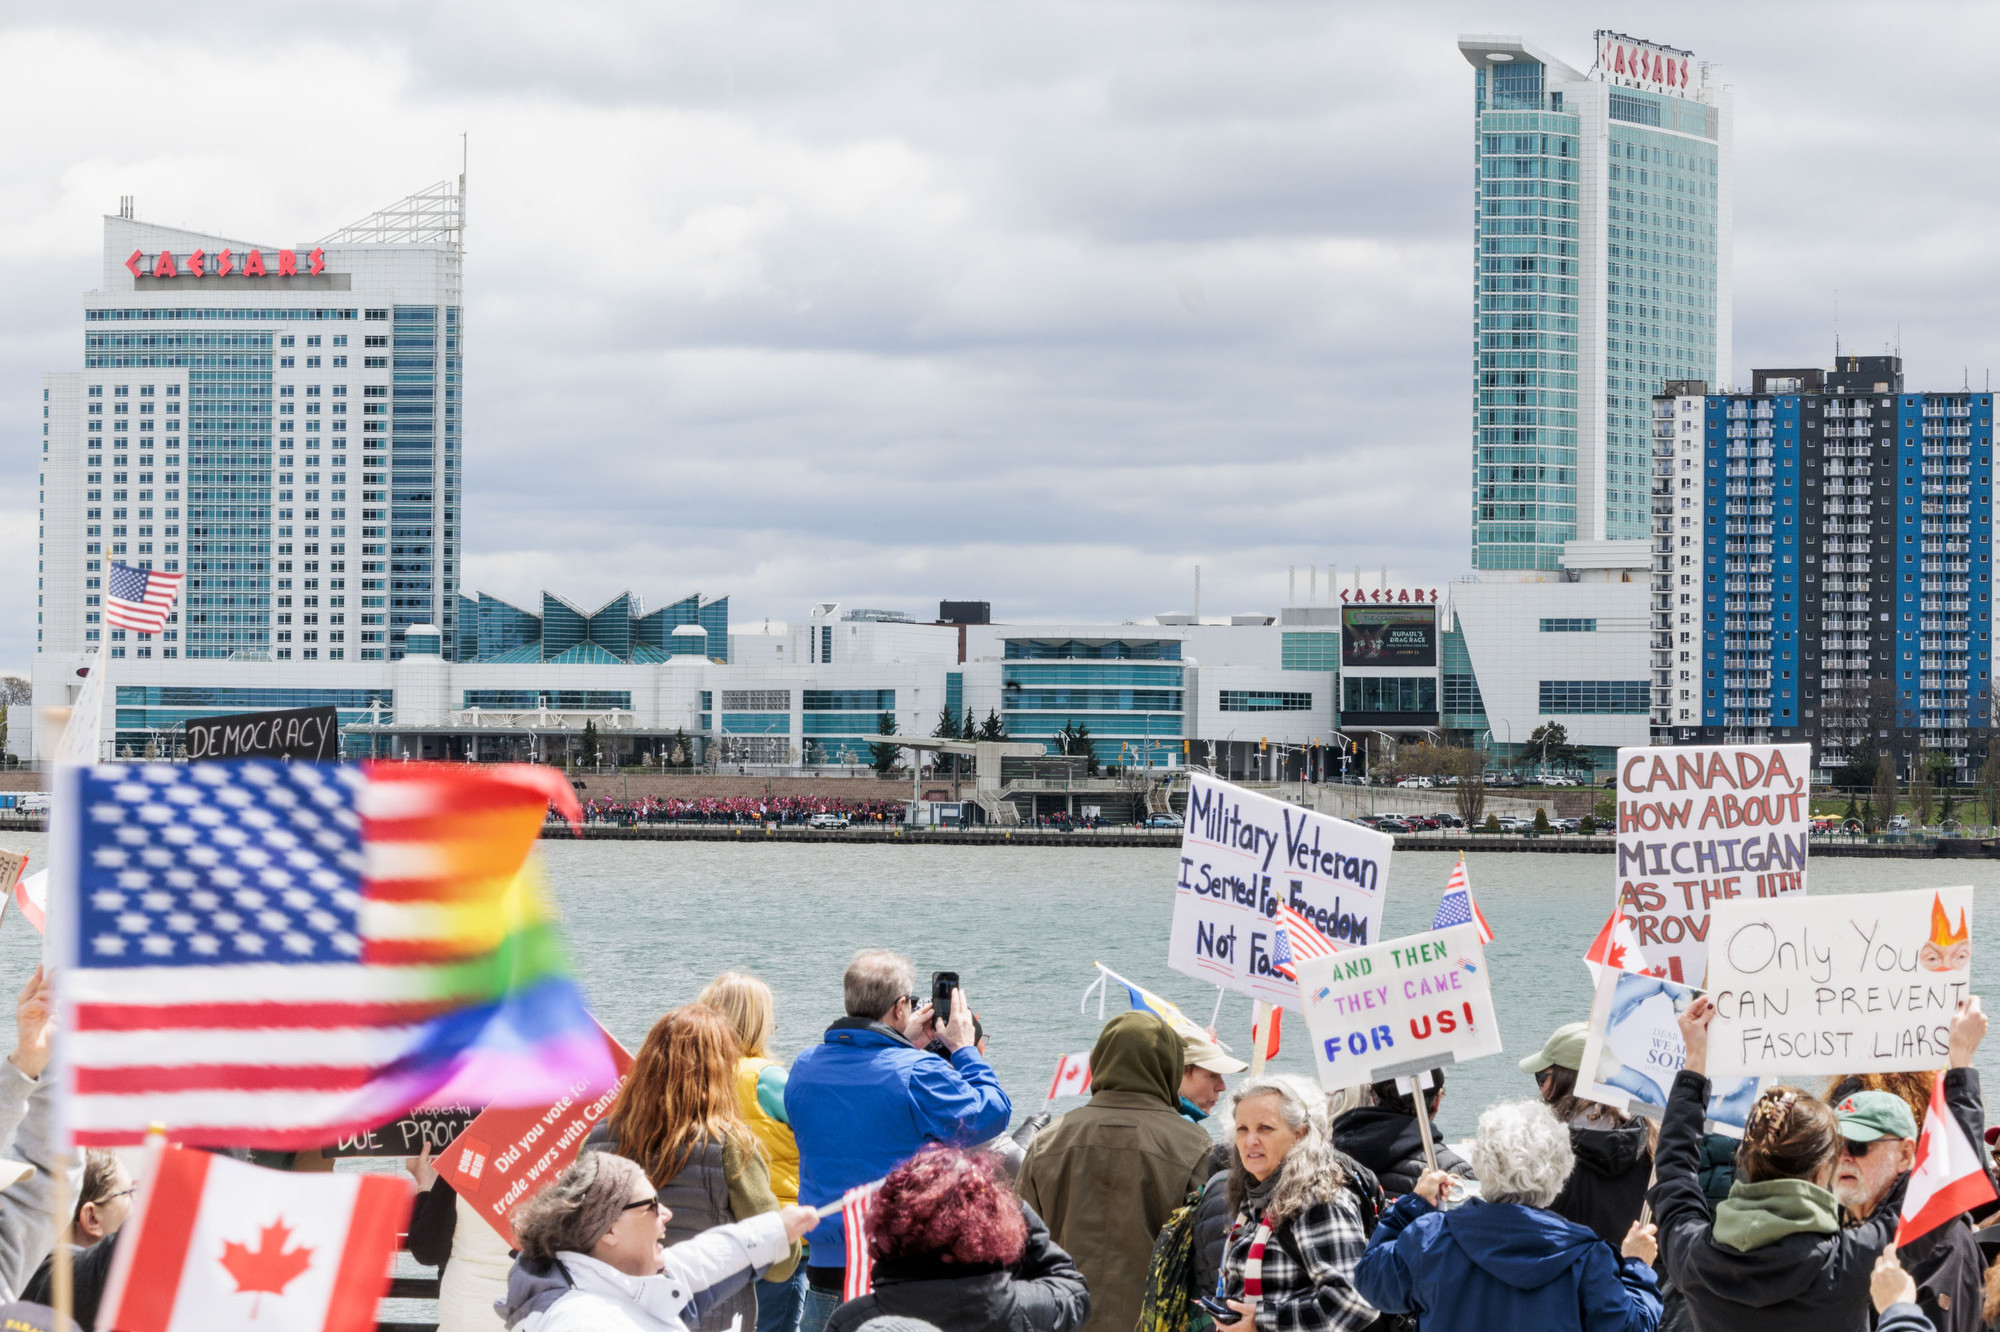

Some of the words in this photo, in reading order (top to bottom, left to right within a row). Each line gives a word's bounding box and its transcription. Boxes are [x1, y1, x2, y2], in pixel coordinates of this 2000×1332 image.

[1602, 40, 1689, 89] CAESARS
[124, 247, 325, 279] CAESARS
[1340, 588, 1438, 603] CAESARS
[187, 716, 332, 768] DEMOCRACY
[1622, 749, 1804, 795] CANADA,
[1619, 799, 1693, 833] HOW
[1698, 793, 1806, 830] ABOUT
[1190, 784, 1279, 872] Military
[1283, 808, 1378, 891] Veteran
[1618, 832, 1806, 877] MICHIGAN
[1178, 856, 1193, 890] I
[1259, 875, 1285, 919] Fo
[1621, 881, 1666, 912] AS
[1673, 876, 1741, 911] THE
[1197, 920, 1237, 965] Not
[1333, 957, 1373, 982] AND
[1390, 940, 1448, 969] THEN
[1728, 922, 1831, 984] Only
[1850, 918, 1919, 973] You
[1334, 985, 1387, 1016] THEY
[1403, 970, 1463, 1000] CAME
[1716, 988, 1789, 1020] CAN
[1816, 982, 1967, 1016] PREVENT
[1324, 1024, 1394, 1063] FOR
[1409, 1001, 1478, 1040] US!
[1652, 1037, 1672, 1051] WE
[1653, 1027, 1679, 1042] DEAR
[1743, 1028, 1853, 1065] FASCIST
[1873, 1024, 1950, 1059] LIARS
[1646, 1049, 1687, 1071] SOR
[410, 1101, 471, 1120] property
[338, 1127, 384, 1151] DUE
[494, 1145, 521, 1174] Did
[518, 1123, 545, 1152] you
[542, 1095, 573, 1125] vote
[458, 1148, 474, 1174] CODE
[493, 1179, 529, 1215] trade
[527, 1147, 559, 1181] wars
[557, 1118, 587, 1151] with
